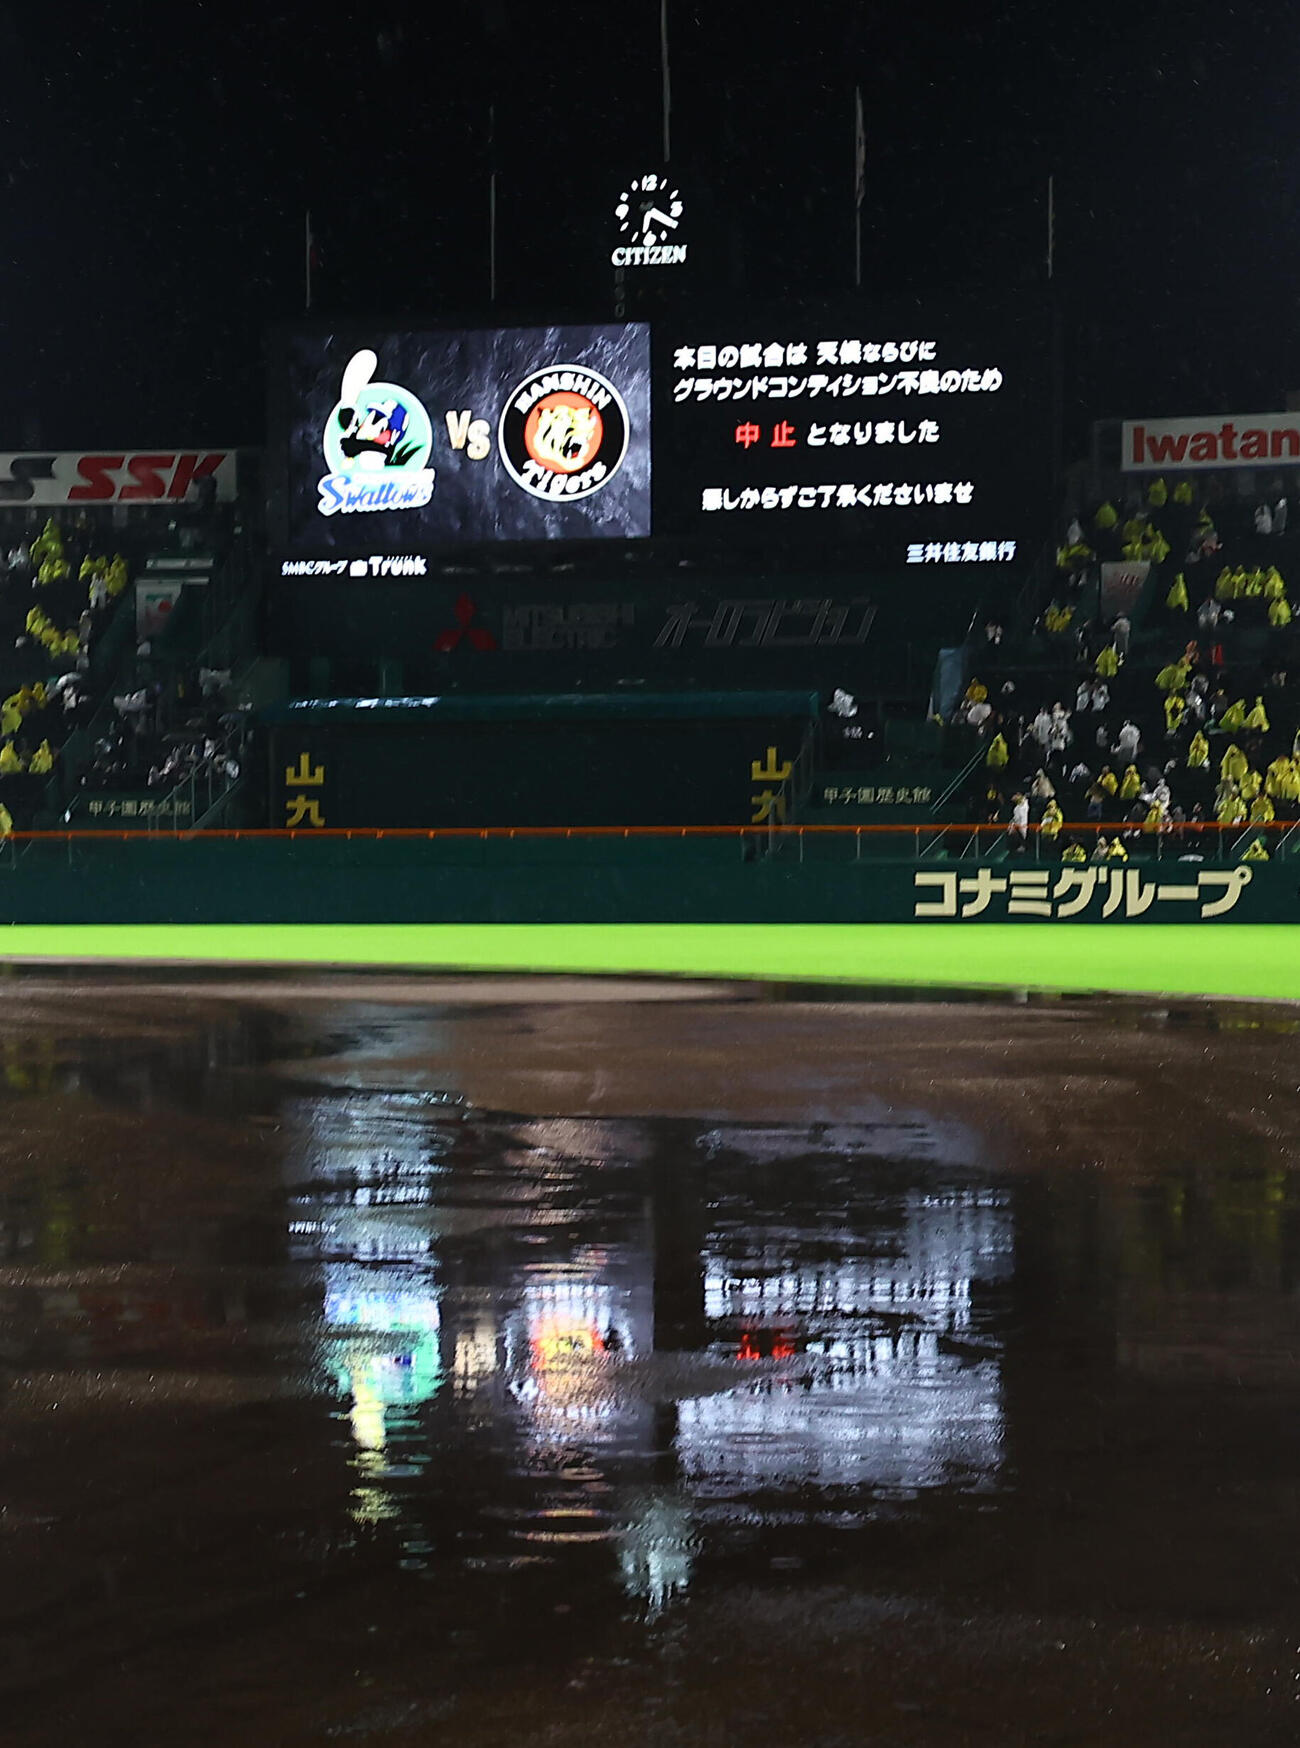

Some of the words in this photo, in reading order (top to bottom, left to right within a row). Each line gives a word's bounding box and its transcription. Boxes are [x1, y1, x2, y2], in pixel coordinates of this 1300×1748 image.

[611, 244, 688, 267] CITIZEN
[673, 342, 808, 371] 本日の試合は
[1134, 423, 1300, 464] Iwatan
[67, 455, 226, 500] SSK
[906, 541, 1017, 563] 三井住友銀行
[286, 753, 325, 827] 山九
[914, 865, 1253, 919] コナミグループ
